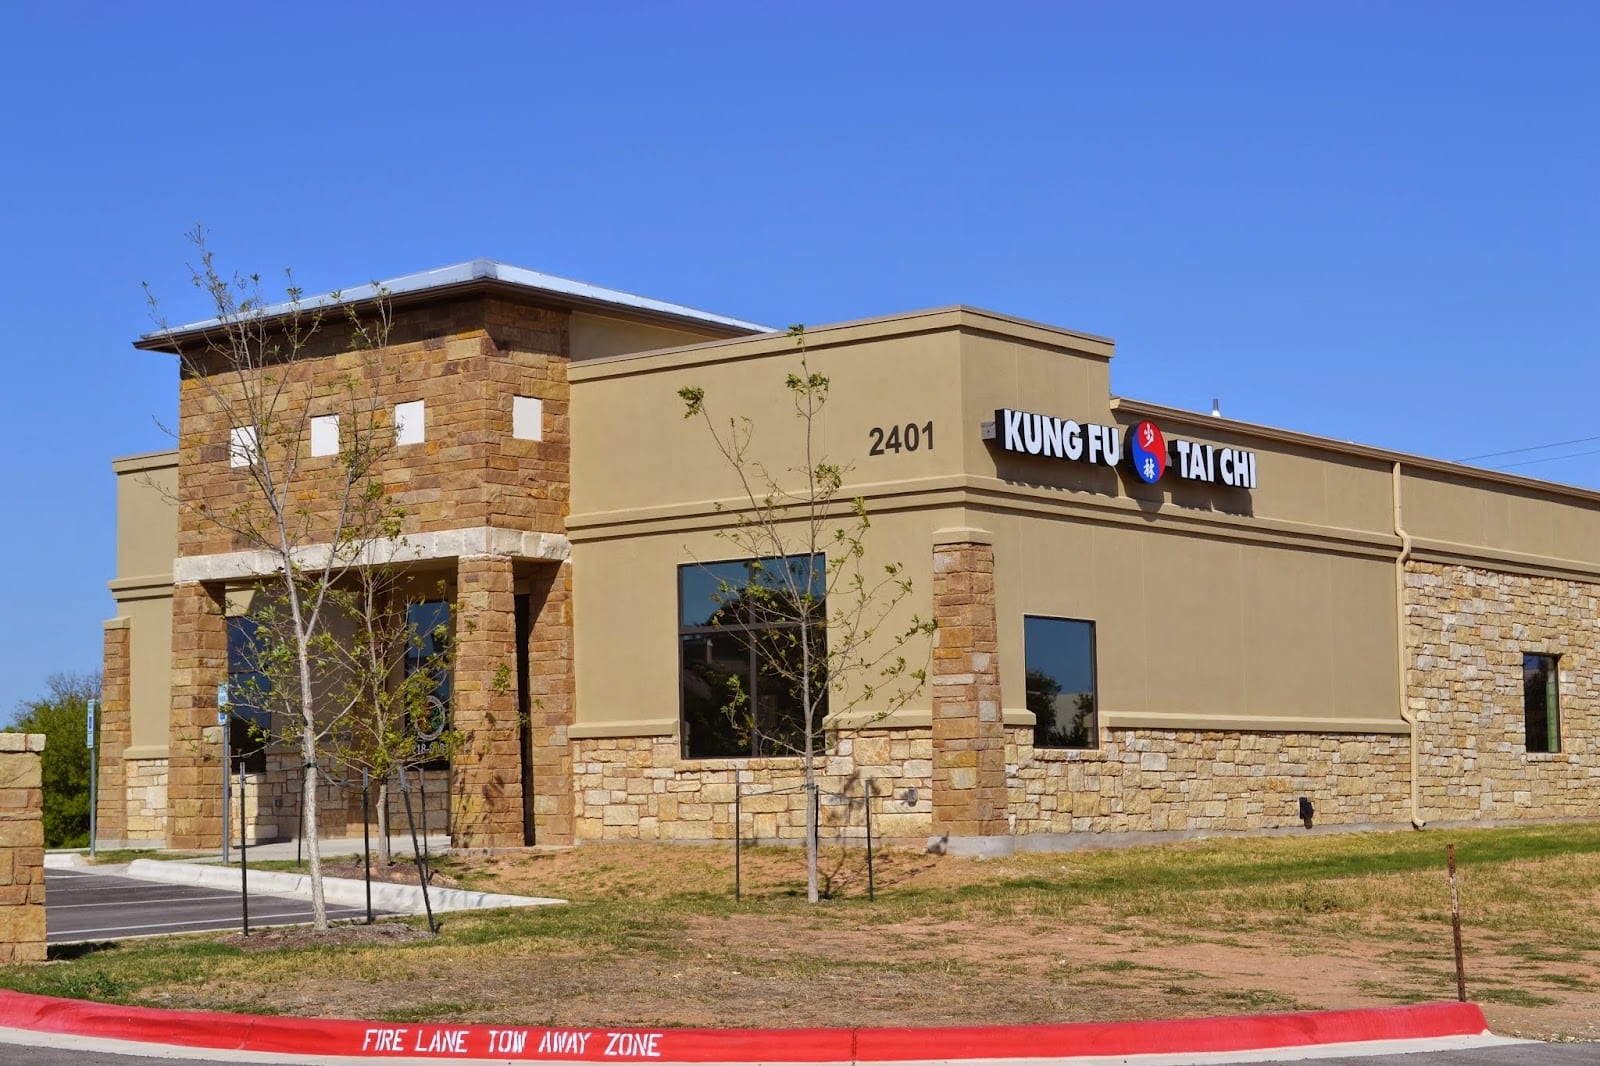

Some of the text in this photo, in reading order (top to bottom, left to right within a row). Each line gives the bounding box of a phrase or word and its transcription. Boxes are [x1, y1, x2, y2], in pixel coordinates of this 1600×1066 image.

[869, 421, 934, 456] 2401
[1003, 408, 1257, 488] KUNG FU TAI CHI
[362, 1029, 663, 1057] FIRE LANE TOW AWAY ZONE
